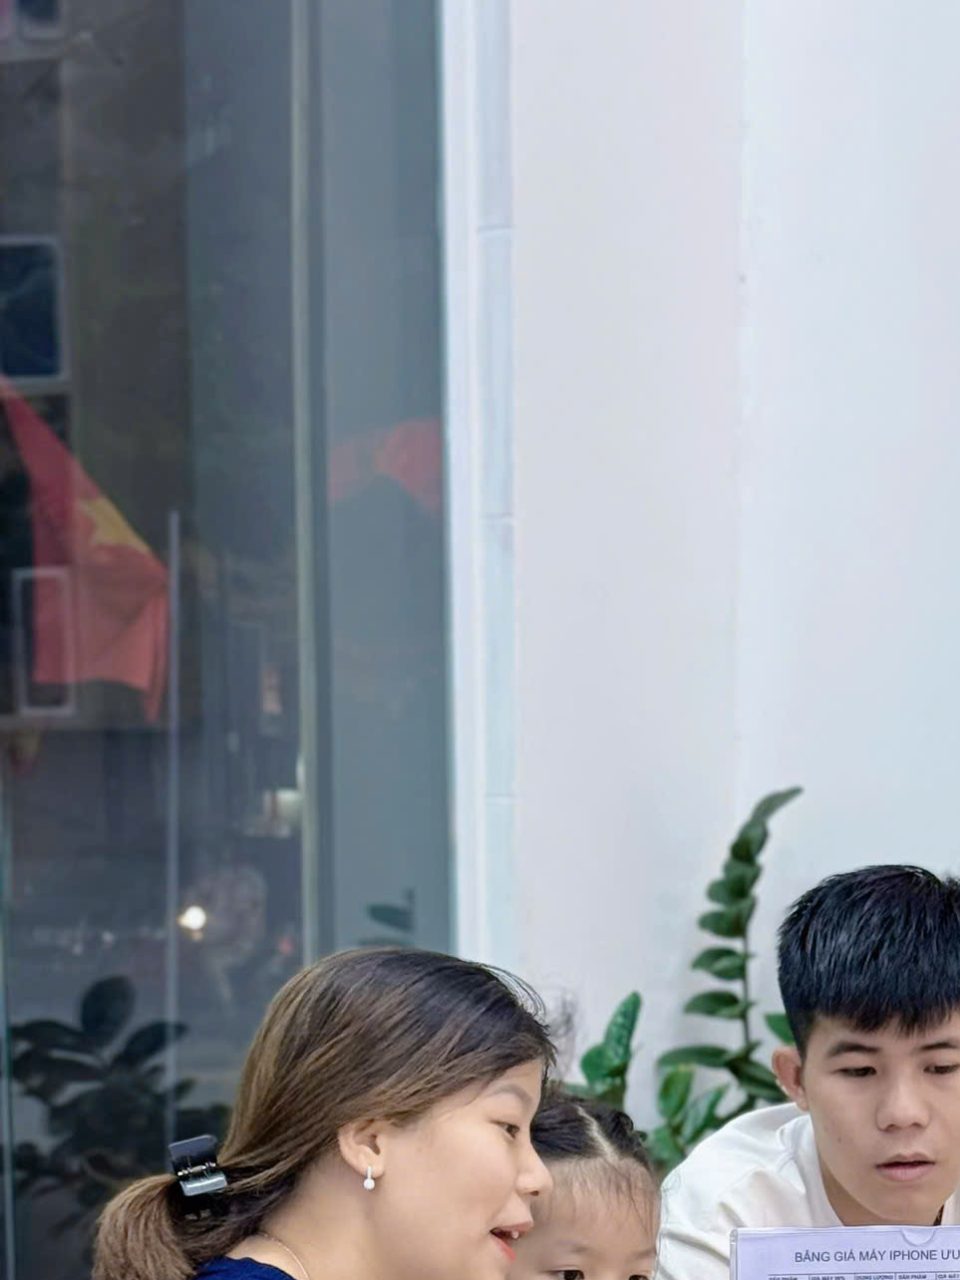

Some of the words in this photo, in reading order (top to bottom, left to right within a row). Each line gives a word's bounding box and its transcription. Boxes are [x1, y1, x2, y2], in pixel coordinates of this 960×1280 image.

[795, 1249, 830, 1263] BẢNG
[834, 1249, 855, 1262] GIÁ
[859, 1248, 886, 1261] MÁY
[890, 1249, 937, 1261] IPHONE
[941, 1249, 960, 1260] ƯU
